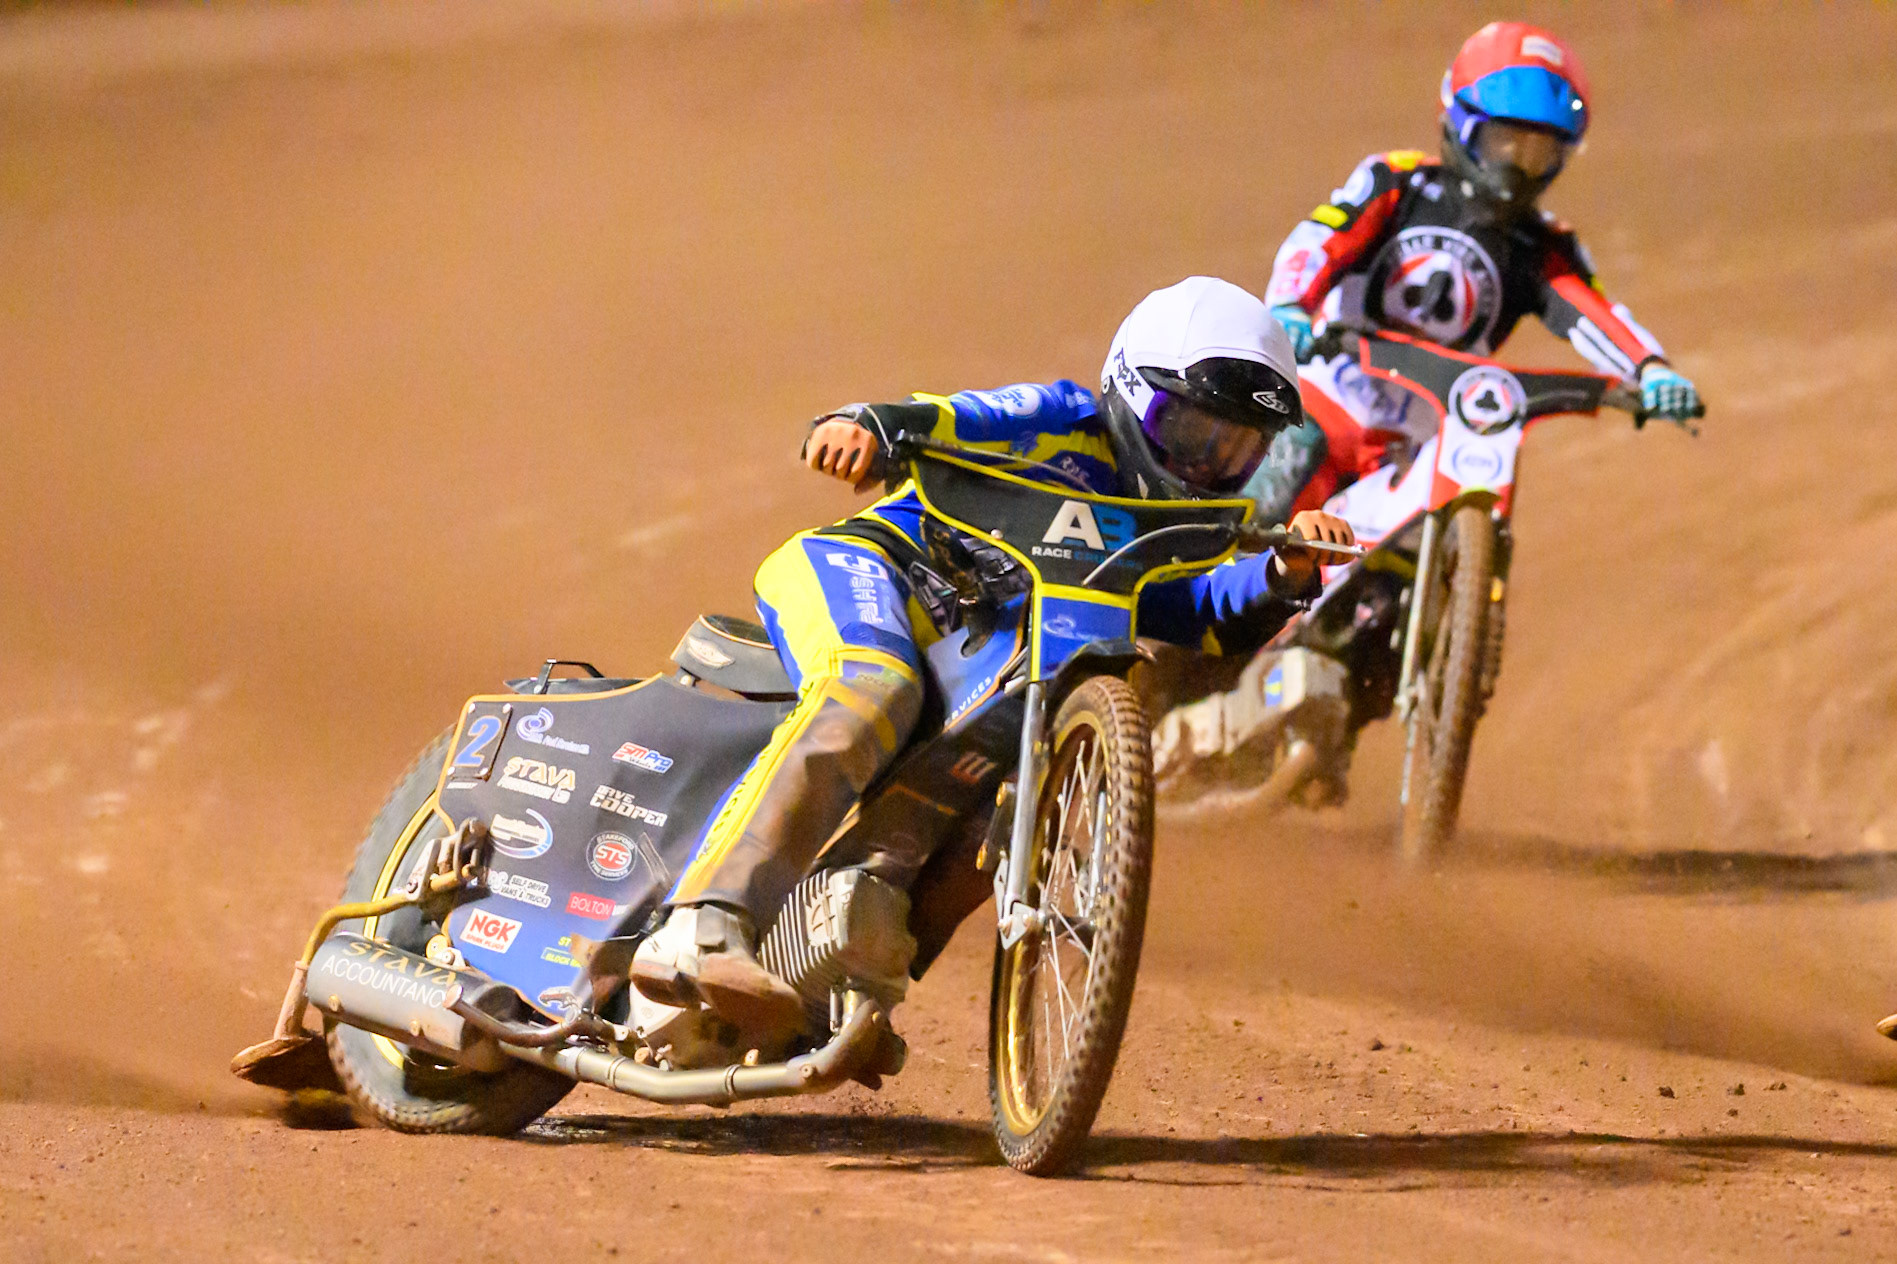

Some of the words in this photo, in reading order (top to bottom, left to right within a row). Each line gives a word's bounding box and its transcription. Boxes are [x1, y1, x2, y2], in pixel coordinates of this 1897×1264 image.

[1042, 500, 1137, 553] AB
[1031, 546, 1072, 560] RACE
[453, 715, 502, 767] 2
[503, 756, 576, 791] STAVA
[590, 793, 668, 827] COOPER
[595, 845, 630, 865] STS
[501, 886, 518, 897] VANS
[525, 893, 550, 905] TRUCKS
[511, 877, 527, 887] SELF
[527, 881, 547, 893] DRIVE
[570, 896, 613, 916] BOLTON
[470, 914, 516, 942] NGK
[321, 954, 451, 1011] ACCOUNTANC
